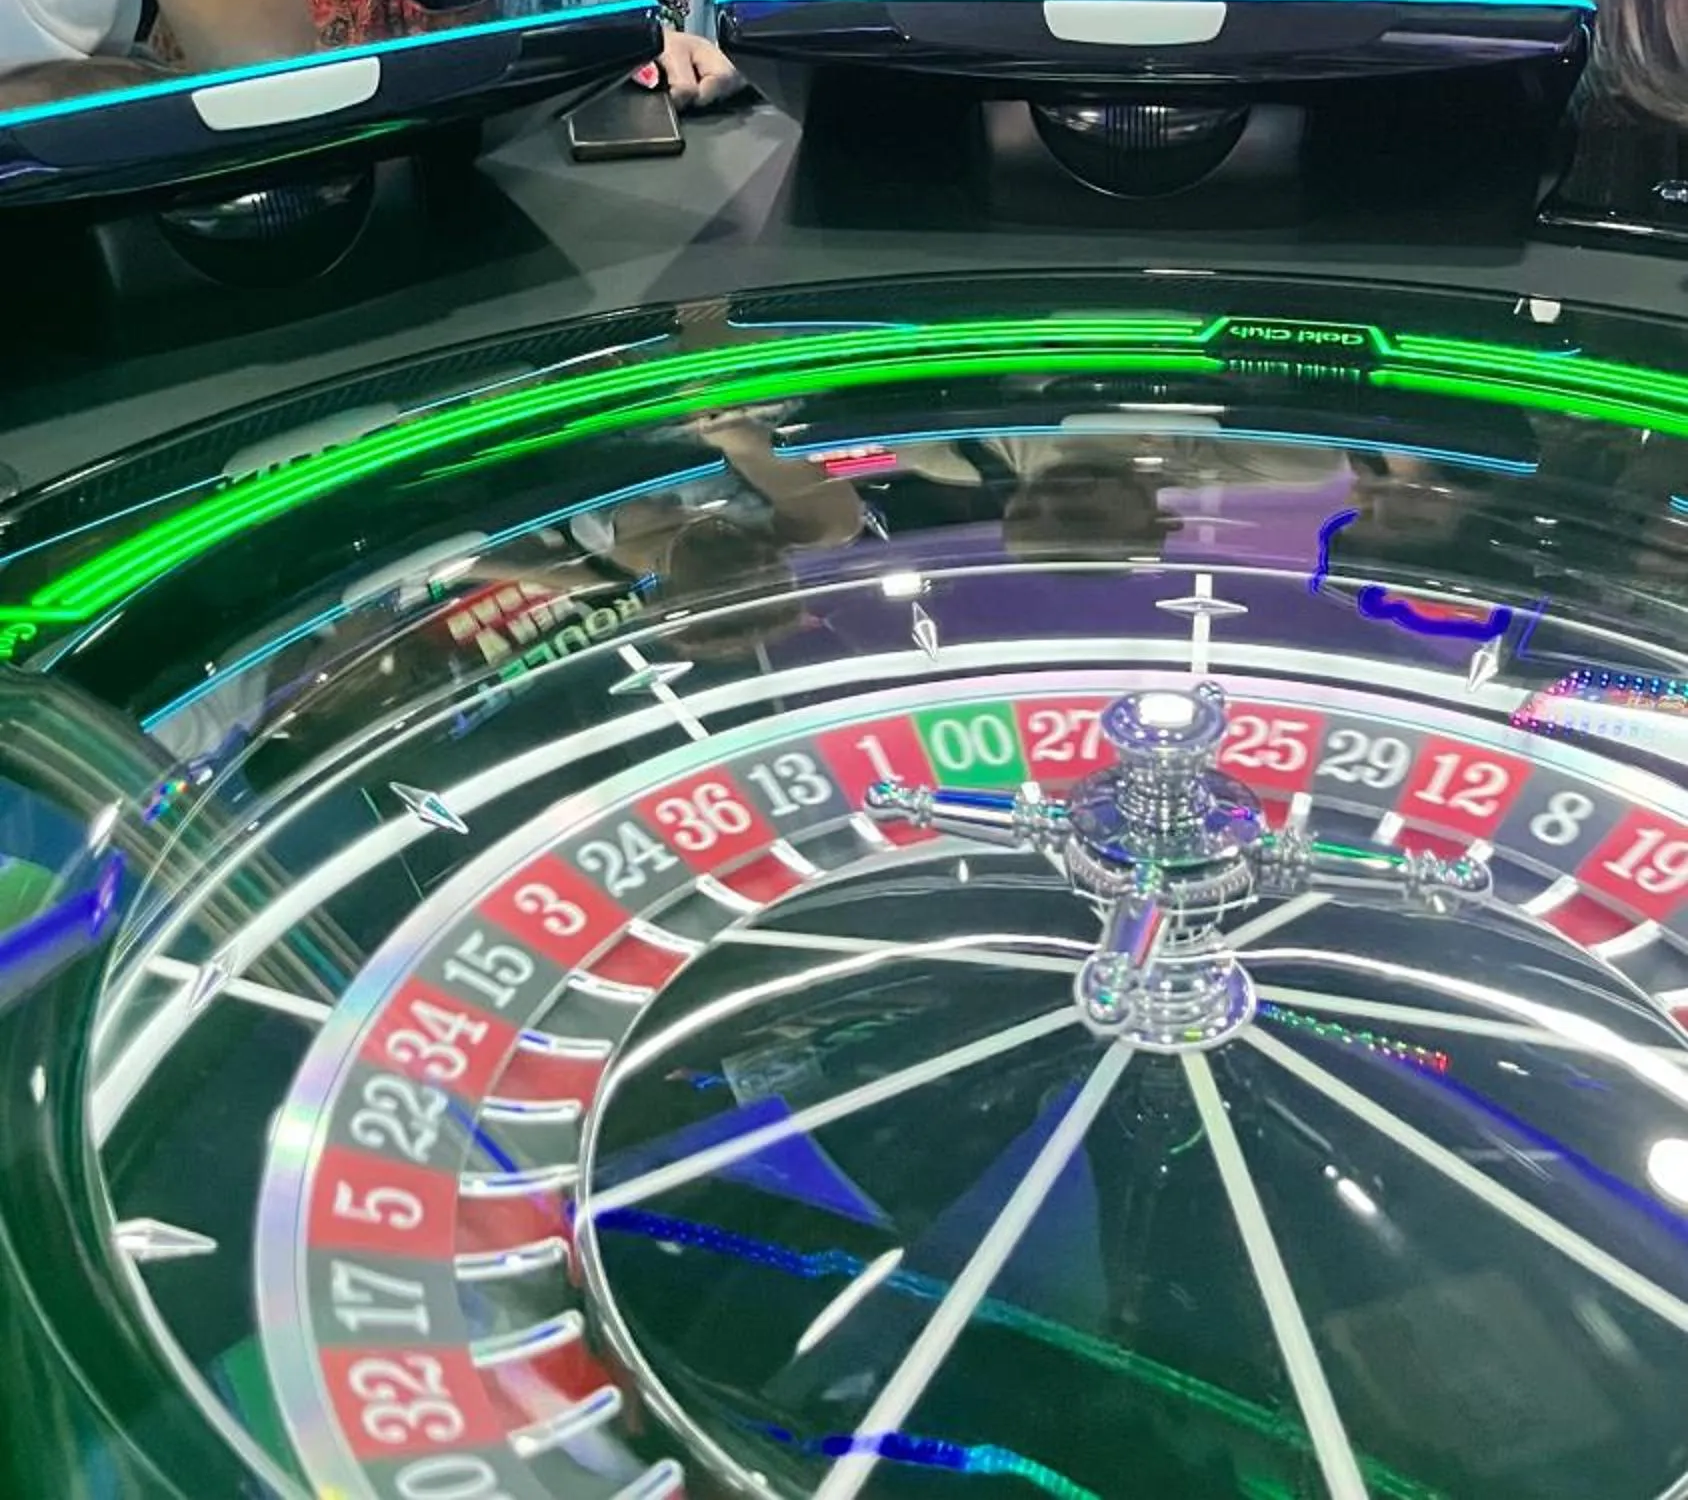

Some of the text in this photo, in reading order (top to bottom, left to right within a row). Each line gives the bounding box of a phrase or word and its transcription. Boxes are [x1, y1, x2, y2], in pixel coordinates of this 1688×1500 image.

[856, 733, 906, 781] 1
[929, 713, 1015, 772] 00
[1027, 708, 1101, 762] 27
[1220, 713, 1311, 771] 25
[1315, 729, 1411, 789] 29
[655, 781, 753, 851] 36
[748, 752, 834, 818] 13
[1414, 753, 1510, 818] 12
[1529, 791, 1595, 846] 8
[575, 820, 679, 898] 24
[1602, 827, 1688, 895] 19
[513, 883, 589, 937] 3
[444, 930, 536, 1008] 15
[386, 999, 489, 1082] 34
[350, 1072, 448, 1164] 22
[331, 1180, 423, 1231] 5
[331, 1259, 430, 1337] 17
[347, 1352, 465, 1444] 32
